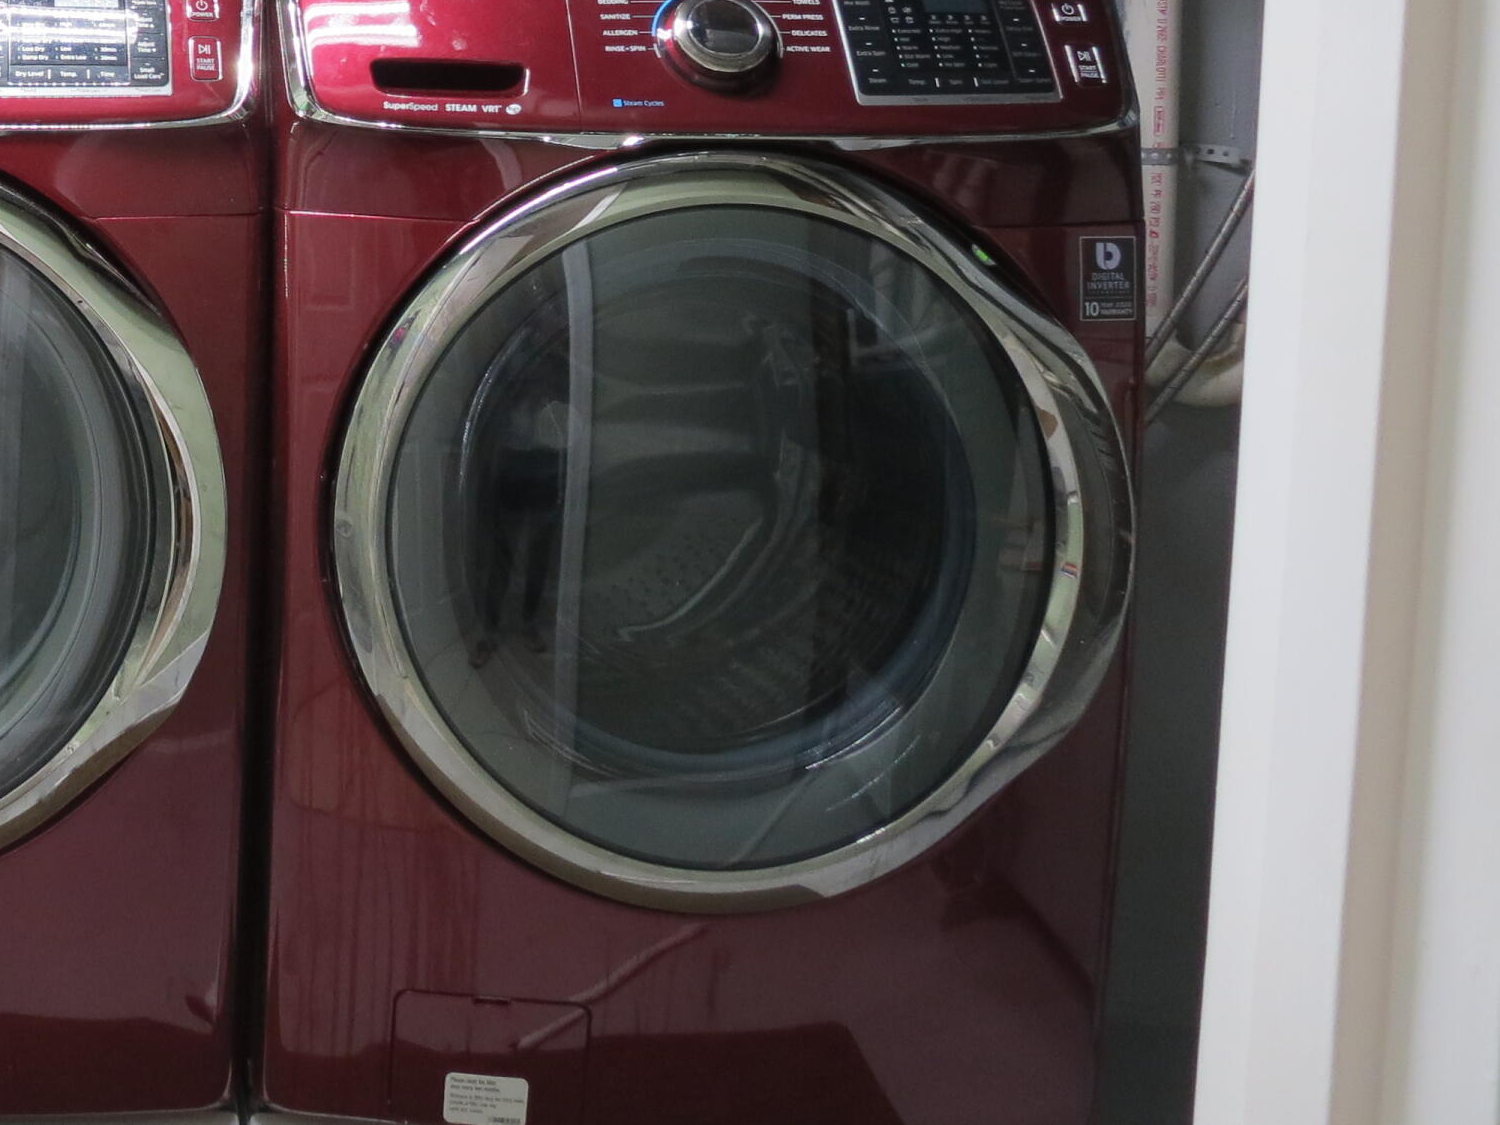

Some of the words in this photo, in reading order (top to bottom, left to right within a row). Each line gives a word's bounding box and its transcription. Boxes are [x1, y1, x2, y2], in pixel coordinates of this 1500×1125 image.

[382, 100, 439, 112] SuperSpeed
[444, 103, 478, 113] STEAM
[623, 99, 644, 107] Steam
[644, 100, 665, 108] Cycles
[1091, 272, 1125, 281] DIGITAL
[1086, 281, 1131, 290] INVERTER
[1084, 302, 1100, 316] 10
